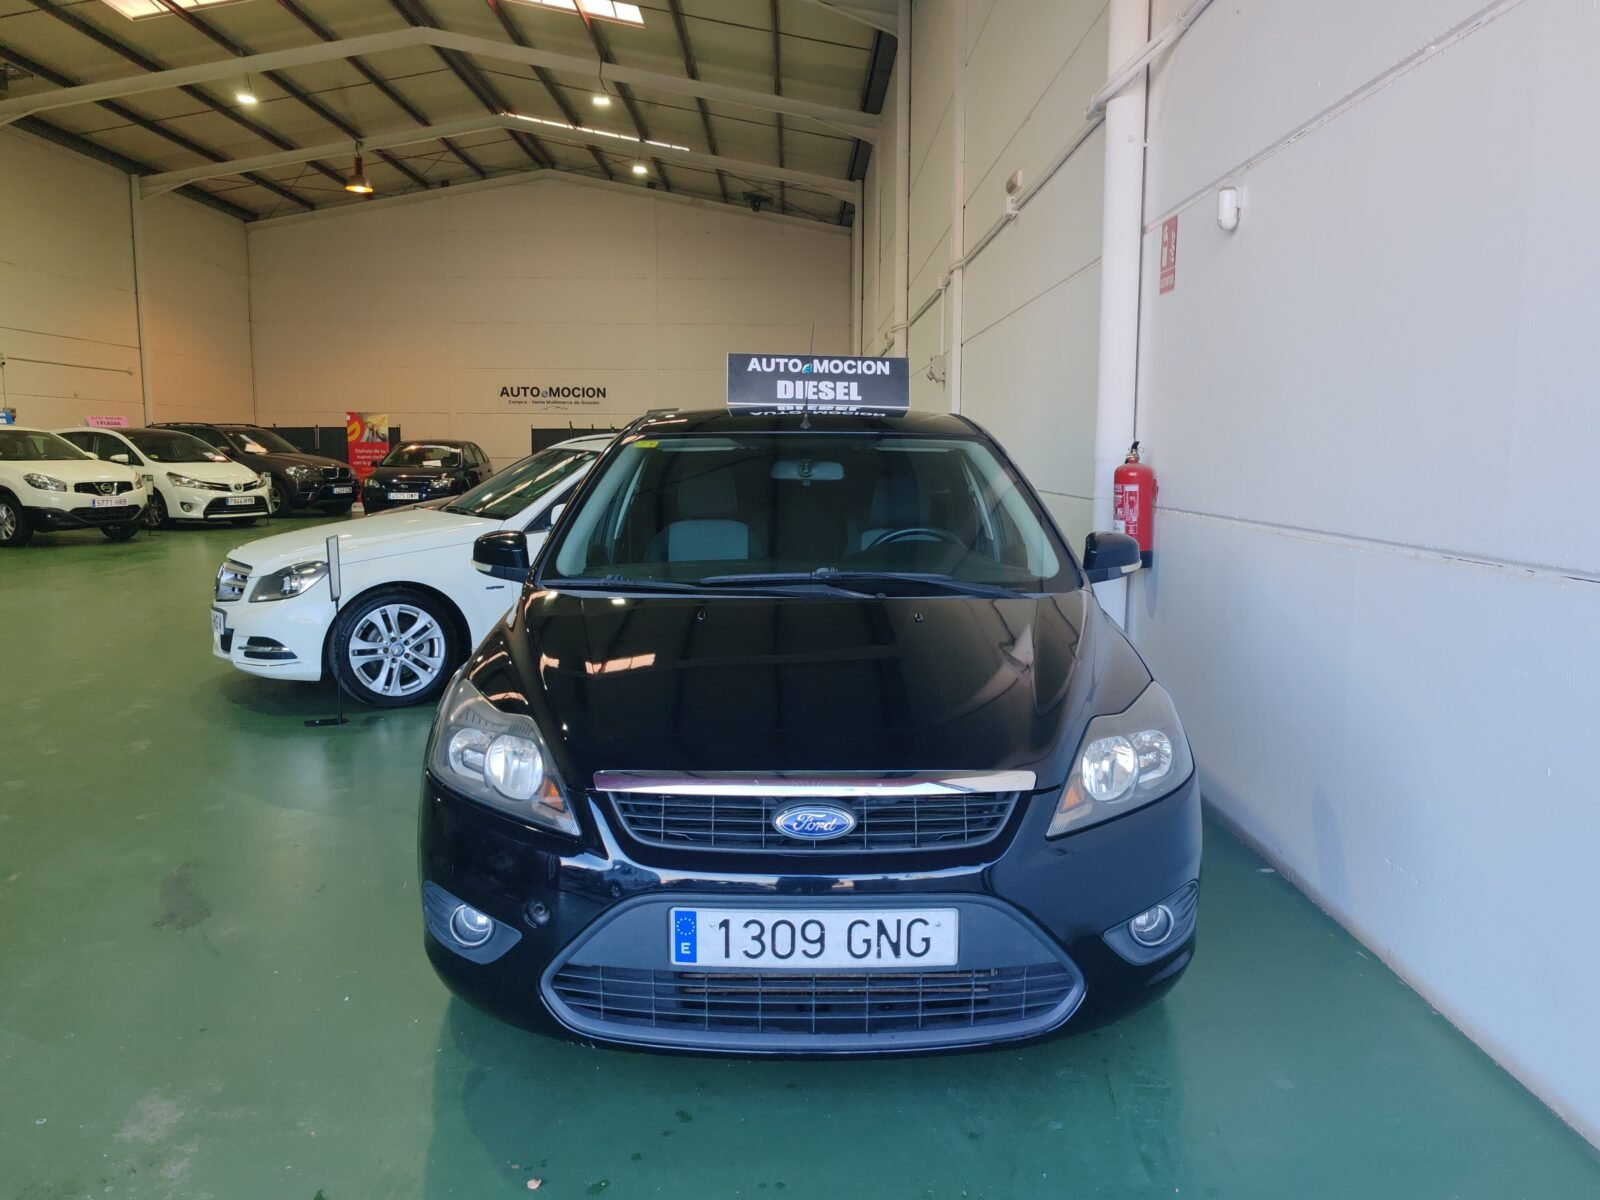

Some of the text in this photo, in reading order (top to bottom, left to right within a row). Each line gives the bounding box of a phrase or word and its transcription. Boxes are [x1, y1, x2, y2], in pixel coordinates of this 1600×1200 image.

[776, 380, 862, 401] DIESEL
[793, 812, 837, 832] Ford
[680, 942, 691, 954] E
[718, 917, 931, 960] 1309 GNG
